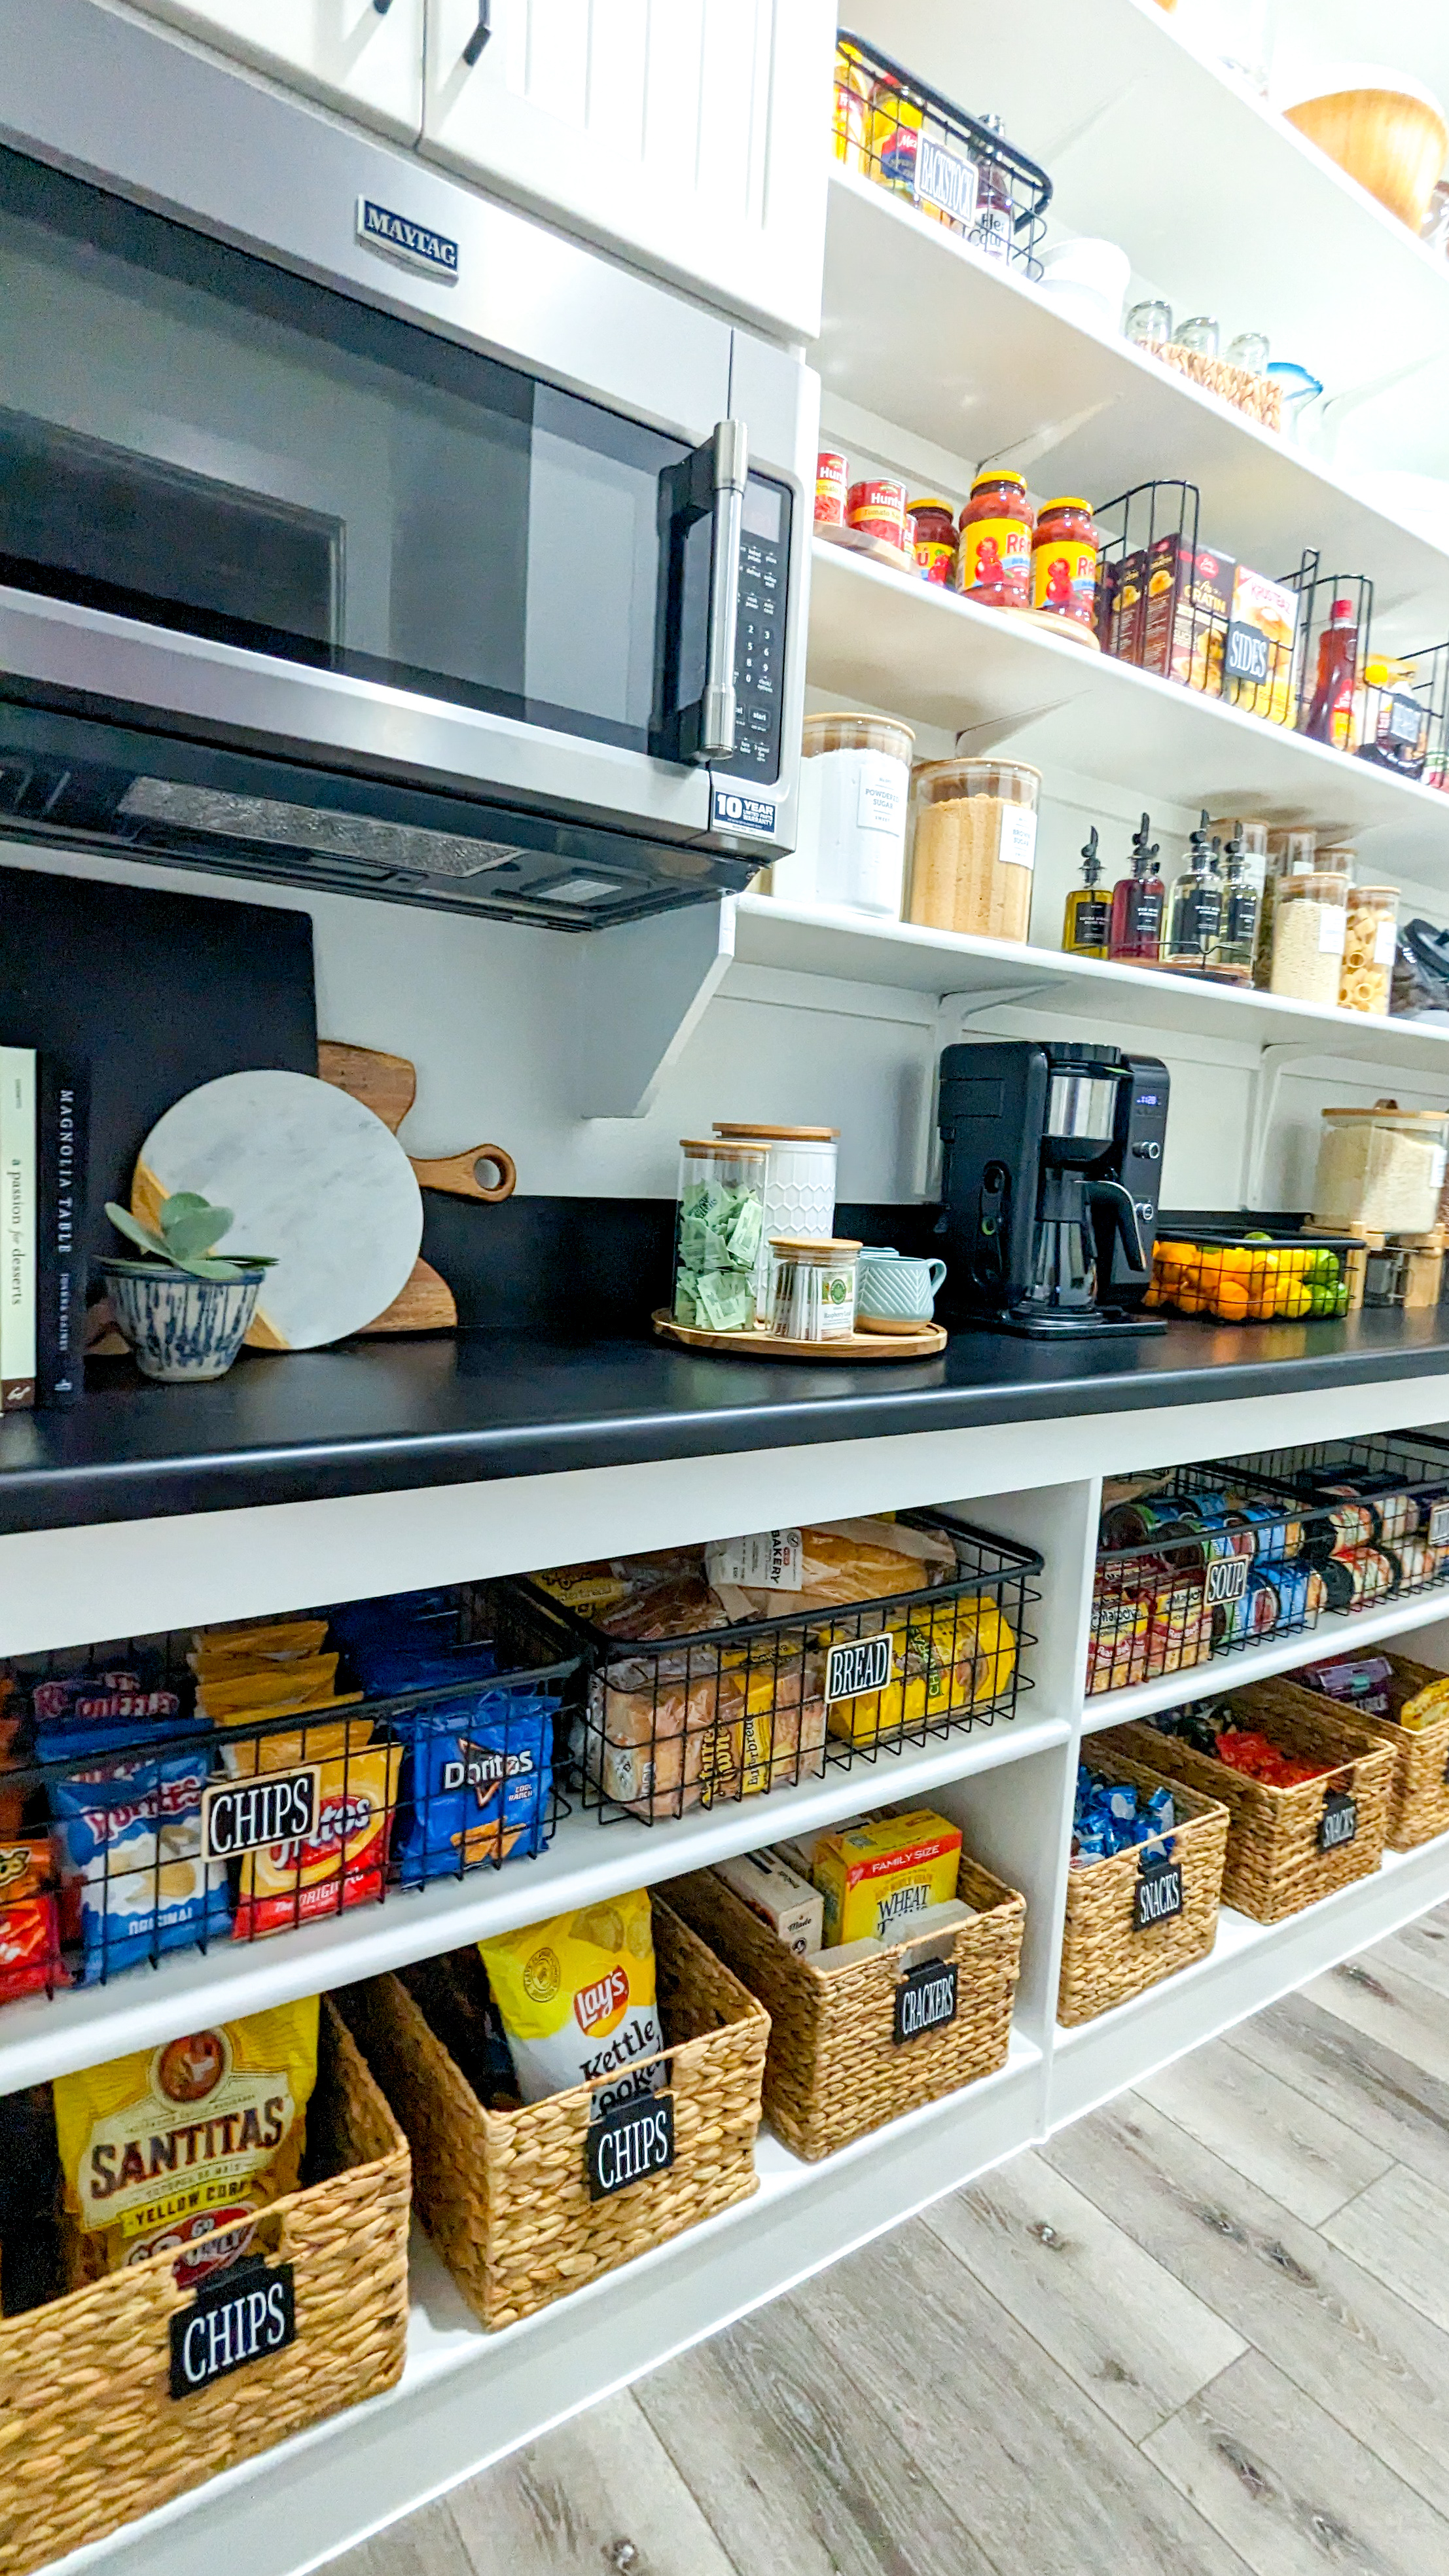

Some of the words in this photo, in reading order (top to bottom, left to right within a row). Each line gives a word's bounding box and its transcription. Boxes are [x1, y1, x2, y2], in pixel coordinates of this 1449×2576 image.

[920, 142, 974, 221] BACKSTOCK
[367, 208, 456, 266] MAYTAG
[747, 642, 753, 652] 5
[748, 625, 753, 634] 2
[764, 631, 770, 639] 3
[747, 658, 752, 667] 8
[763, 663, 768, 672] 9
[764, 648, 770, 657] 6
[1230, 630, 1268, 679] SIDES
[746, 674, 751, 683] 0
[717, 794, 743, 819] 10
[743, 800, 774, 816] YEAR
[865, 788, 899, 803] POWDERED
[873, 798, 893, 809] SUGAR
[743, 815, 772, 826] WARRANTY
[59, 1090, 75, 1189] MAGNOLIA
[7, 1170, 24, 1225] passion
[58, 1198, 74, 1253] TABLE
[10, 1249, 26, 1305] desserts
[770, 1530, 783, 1584] BAKERY
[1208, 1561, 1244, 1601] SOUP
[831, 1641, 888, 1697] BREAD
[445, 1750, 533, 1789] Doritos
[516, 1784, 532, 1793] COOL
[209, 1777, 309, 1854] CHIPS
[509, 1791, 532, 1801] RANCH
[872, 1853, 913, 1873] FAMILY
[914, 1844, 940, 1859] SIZE
[876, 1884, 932, 1919] WHEAT
[1141, 1872, 1178, 1923] SNACKS
[787, 1918, 812, 1932] Made
[577, 1971, 626, 2028] Lay's
[903, 1974, 954, 2035] CRACKERS
[579, 2020, 655, 2081] Kettle
[90, 2096, 285, 2199] SANTITAS
[598, 2109, 669, 2189] CHIPS
[135, 2190, 200, 2227] YELLOW
[183, 2282, 285, 2383] CHIPS
